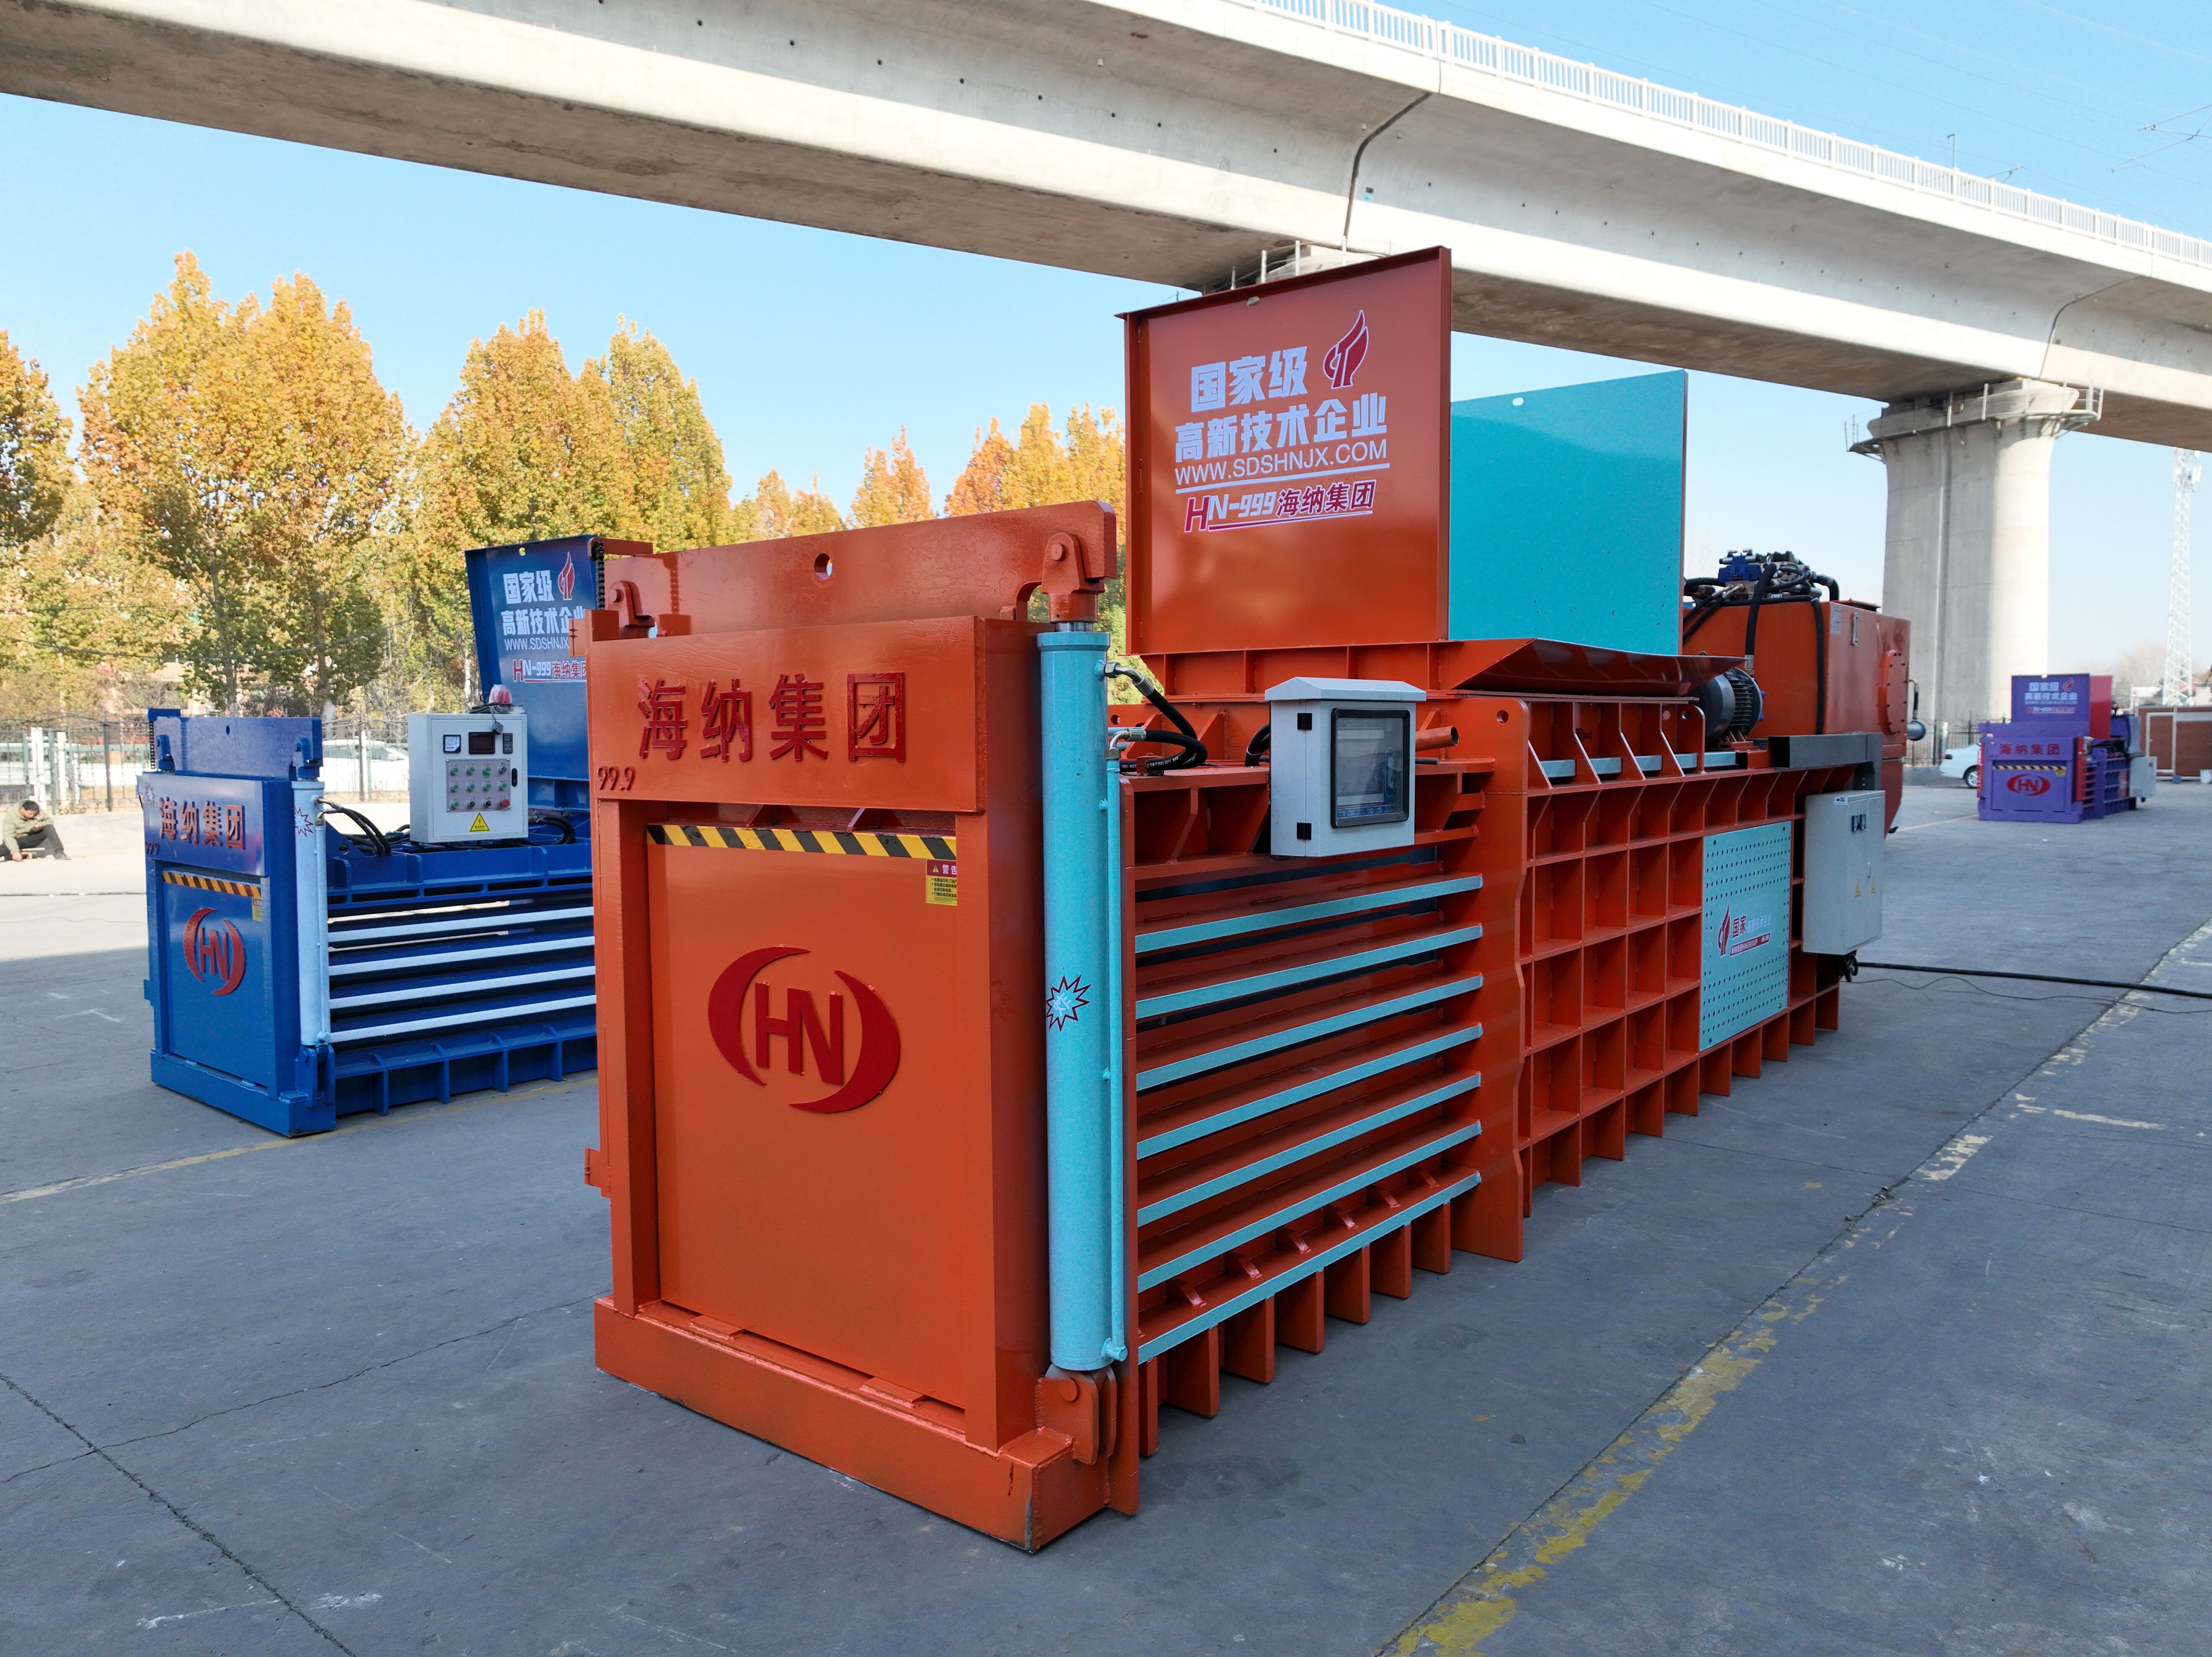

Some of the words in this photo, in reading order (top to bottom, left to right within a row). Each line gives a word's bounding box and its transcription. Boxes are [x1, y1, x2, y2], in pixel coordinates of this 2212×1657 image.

[1191, 346, 1308, 413] 国家级
[1175, 392, 1387, 462] 高新技术企业
[1175, 439, 1387, 485] WWW.SDSHNJX.COM
[503, 570, 555, 604] 国家级
[637, 672, 906, 763] 海纳集团
[597, 765, 636, 791] 99.9
[2018, 778, 2039, 792] HN
[158, 796, 245, 850] 海纳集团
[942, 864, 957, 875] 警告
[198, 927, 230, 981] HN
[1052, 992, 1072, 1017] 炸
[755, 980, 843, 1087] HN
